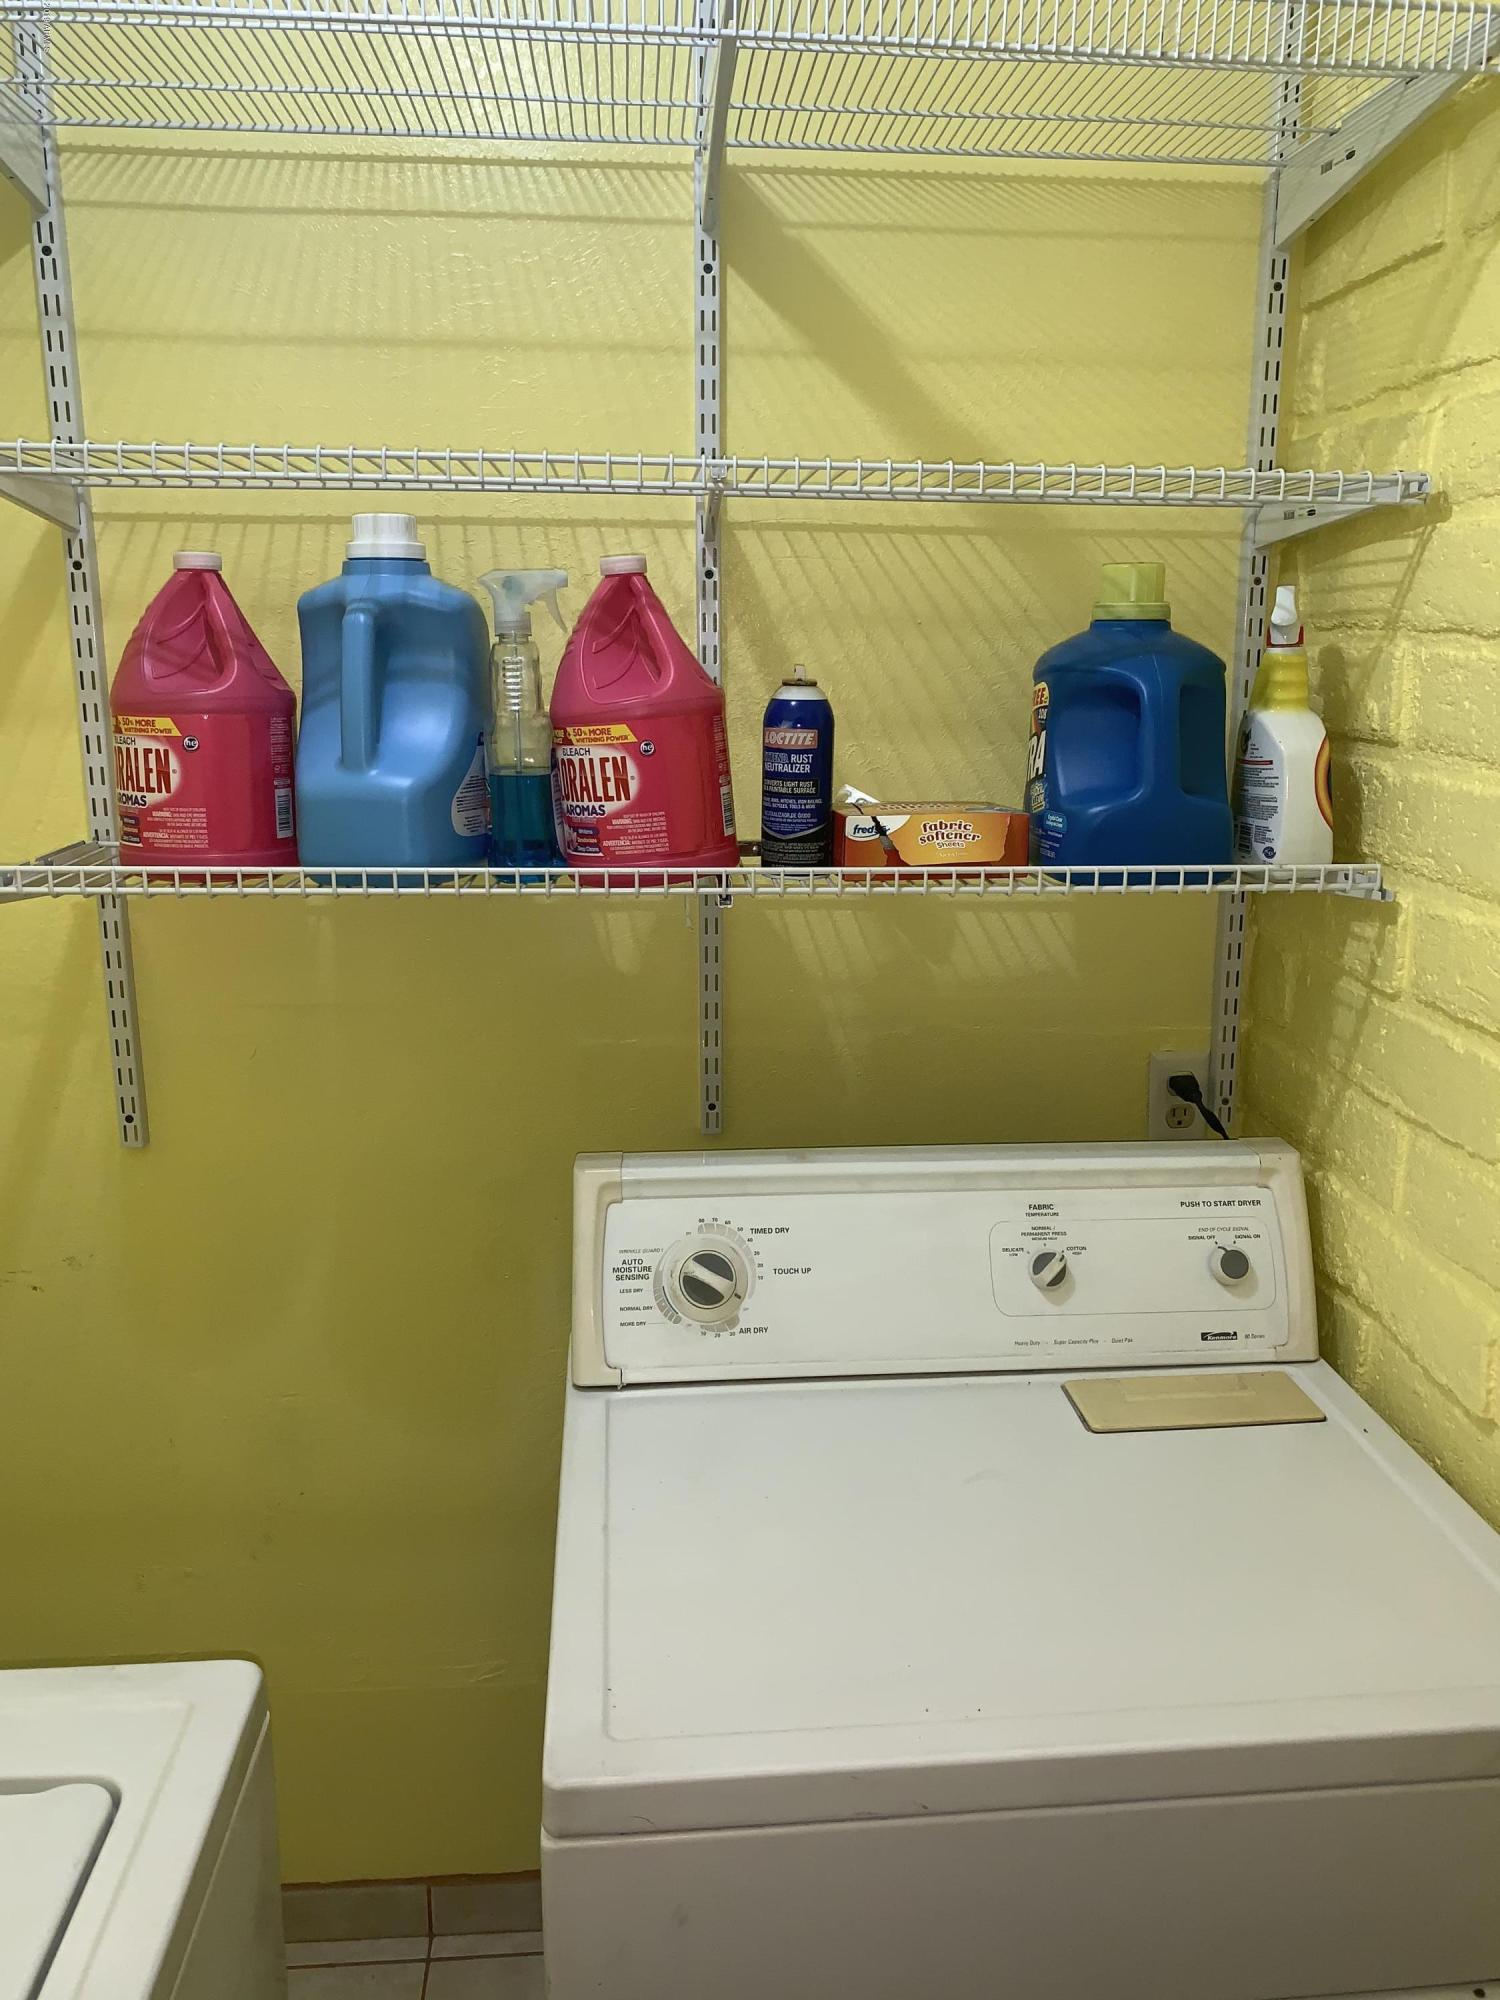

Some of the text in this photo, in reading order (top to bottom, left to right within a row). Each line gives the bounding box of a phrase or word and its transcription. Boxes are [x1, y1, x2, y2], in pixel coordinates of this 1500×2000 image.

[135, 719, 156, 728] MORE
[588, 727, 612, 737] MORE
[606, 734, 629, 742] POWER
[765, 731, 815, 745] LOCTITE
[562, 748, 591, 757] BLEACH
[790, 754, 813, 764] RUST
[765, 762, 811, 773] NEUTRALIZER
[566, 804, 606, 816] AROMAS
[922, 820, 973, 833] fabric
[919, 830, 981, 845] softener
[1028, 1203, 1055, 1211] FABRIC
[750, 1227, 773, 1235] TIMED
[621, 1258, 644, 1266] AUTO
[612, 1265, 653, 1273] MOISTURE
[773, 1267, 799, 1275] TOUCH
[615, 1273, 650, 1281] SENSING
[753, 1326, 769, 1334] DRY
